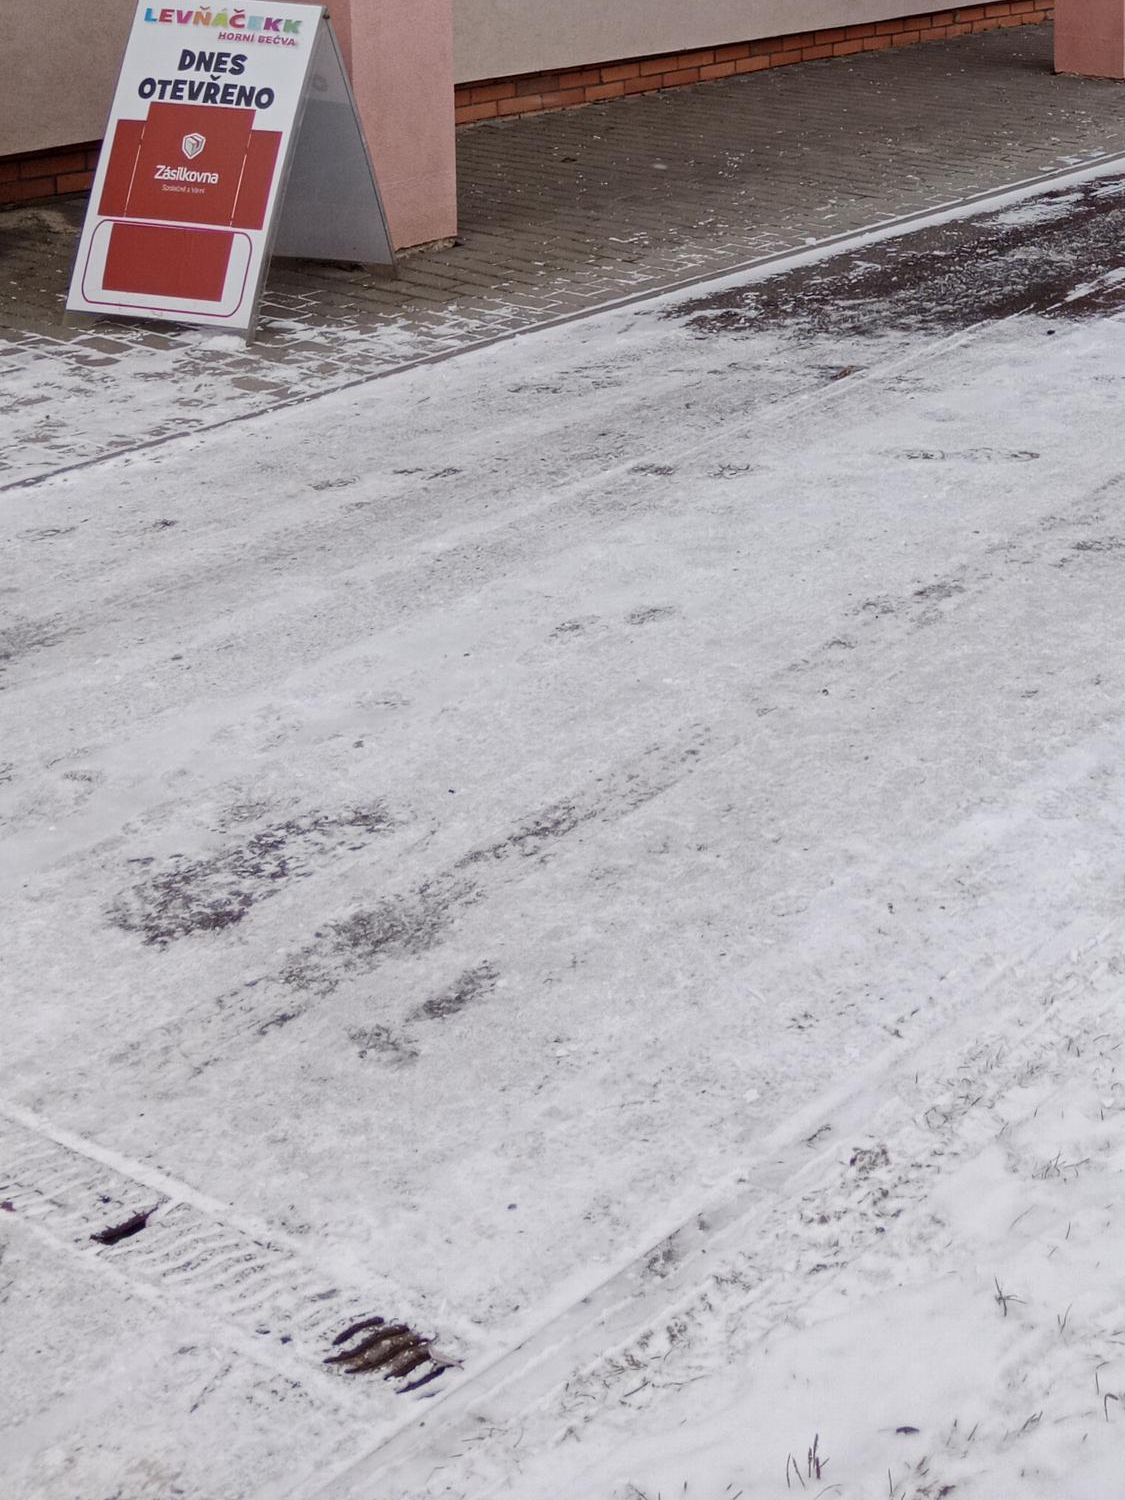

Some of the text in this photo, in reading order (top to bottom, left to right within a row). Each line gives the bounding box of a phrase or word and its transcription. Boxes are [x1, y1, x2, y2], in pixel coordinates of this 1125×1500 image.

[144, 5, 303, 34] LEVŇÁČEKK
[217, 31, 297, 47] HORNÍ BEČVA
[177, 48, 248, 75] DNES
[138, 74, 275, 109] OTEVŘENO
[153, 164, 219, 185] Zásilkovna
